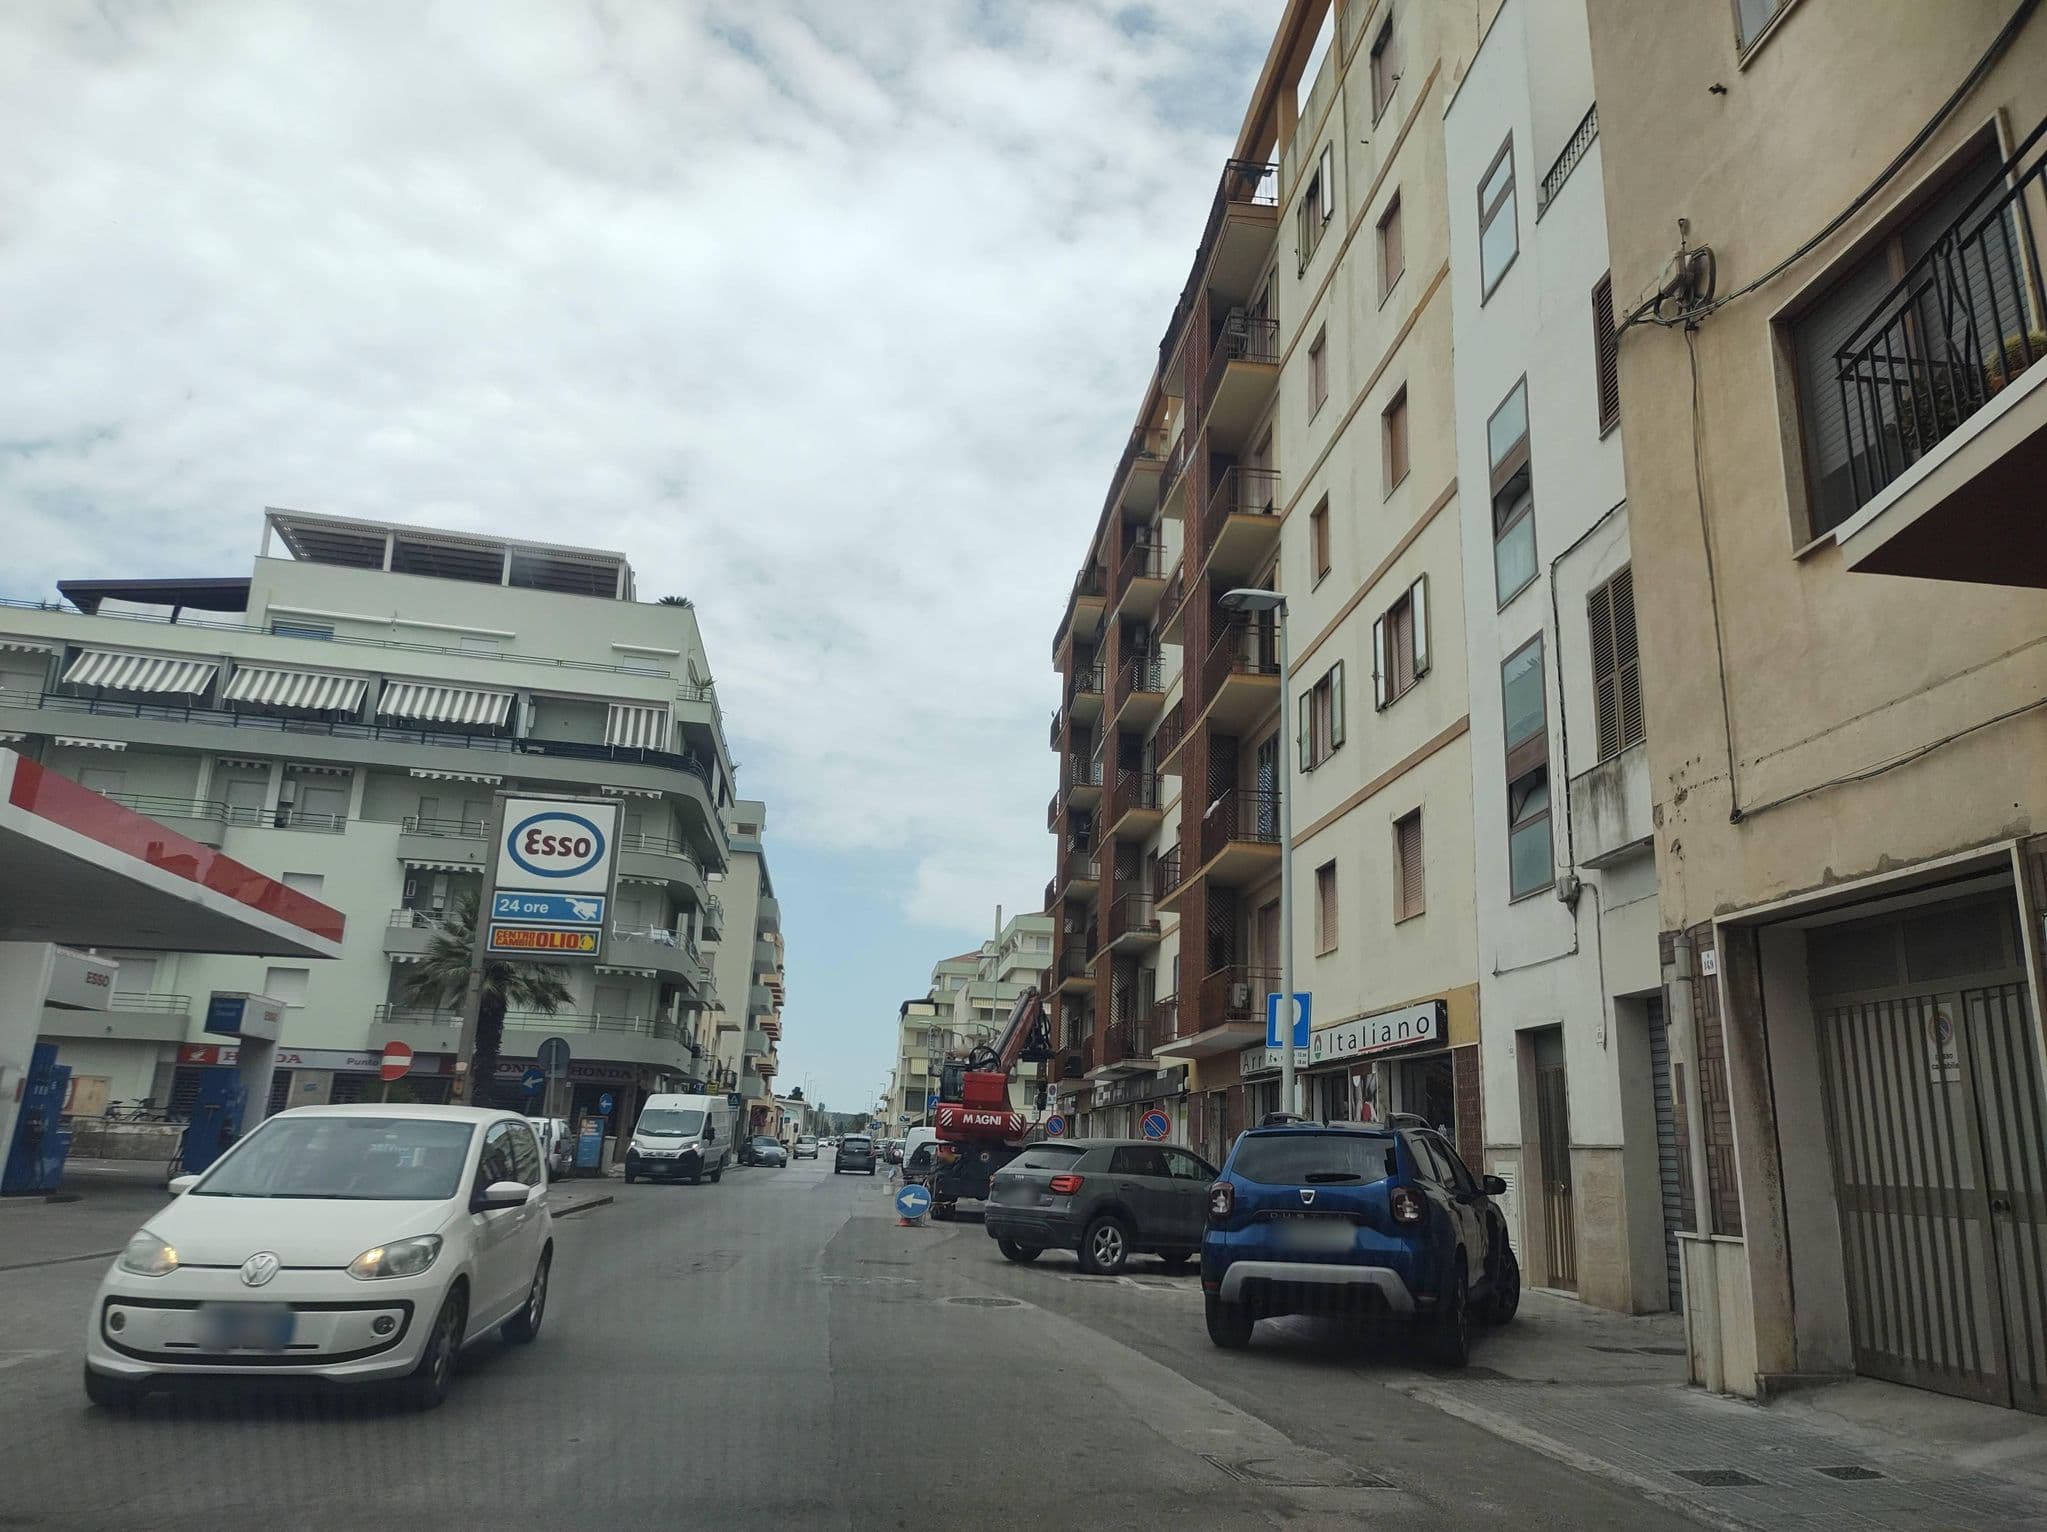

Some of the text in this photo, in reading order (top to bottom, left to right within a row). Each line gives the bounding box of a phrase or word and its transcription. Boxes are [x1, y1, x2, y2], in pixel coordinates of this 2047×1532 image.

[525, 828, 592, 858] Esso
[499, 898, 549, 913] 24 ore
[535, 932, 579, 949] OLIO
[86, 971, 110, 988] ESSO
[1329, 1016, 1430, 1053] Italiano
[346, 1057, 379, 1067] Punto
[571, 1066, 633, 1079] HONDA
[963, 1114, 1002, 1125] MAGNI
